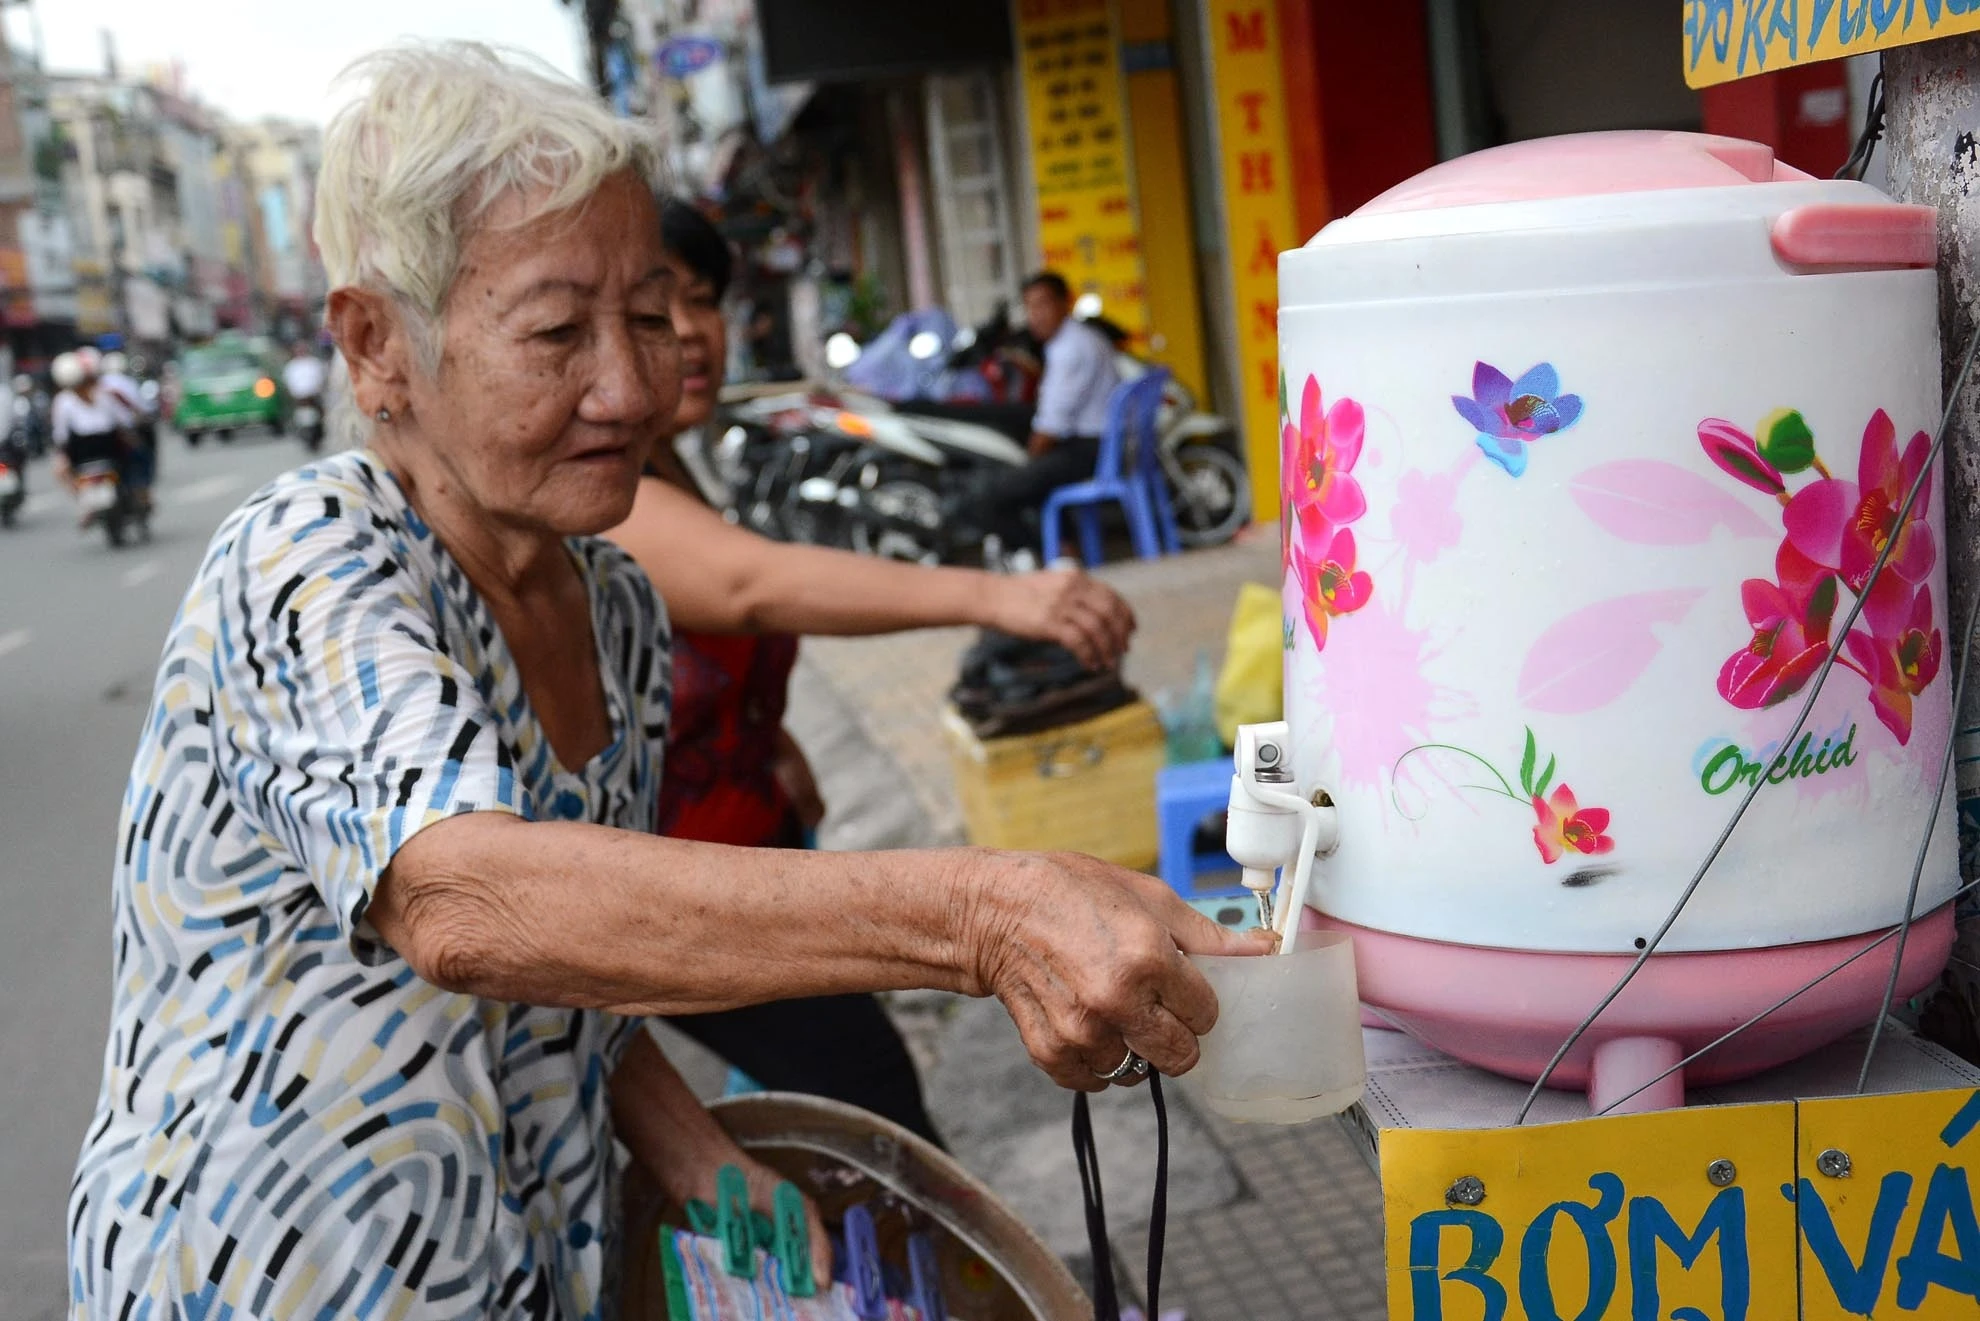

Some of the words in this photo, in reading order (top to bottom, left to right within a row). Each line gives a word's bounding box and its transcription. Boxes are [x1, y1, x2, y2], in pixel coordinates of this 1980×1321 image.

[1701, 723, 1858, 795] Orchid
[1409, 1172, 1750, 1321] BƠM
[1781, 1089, 1980, 1319] VÁ
